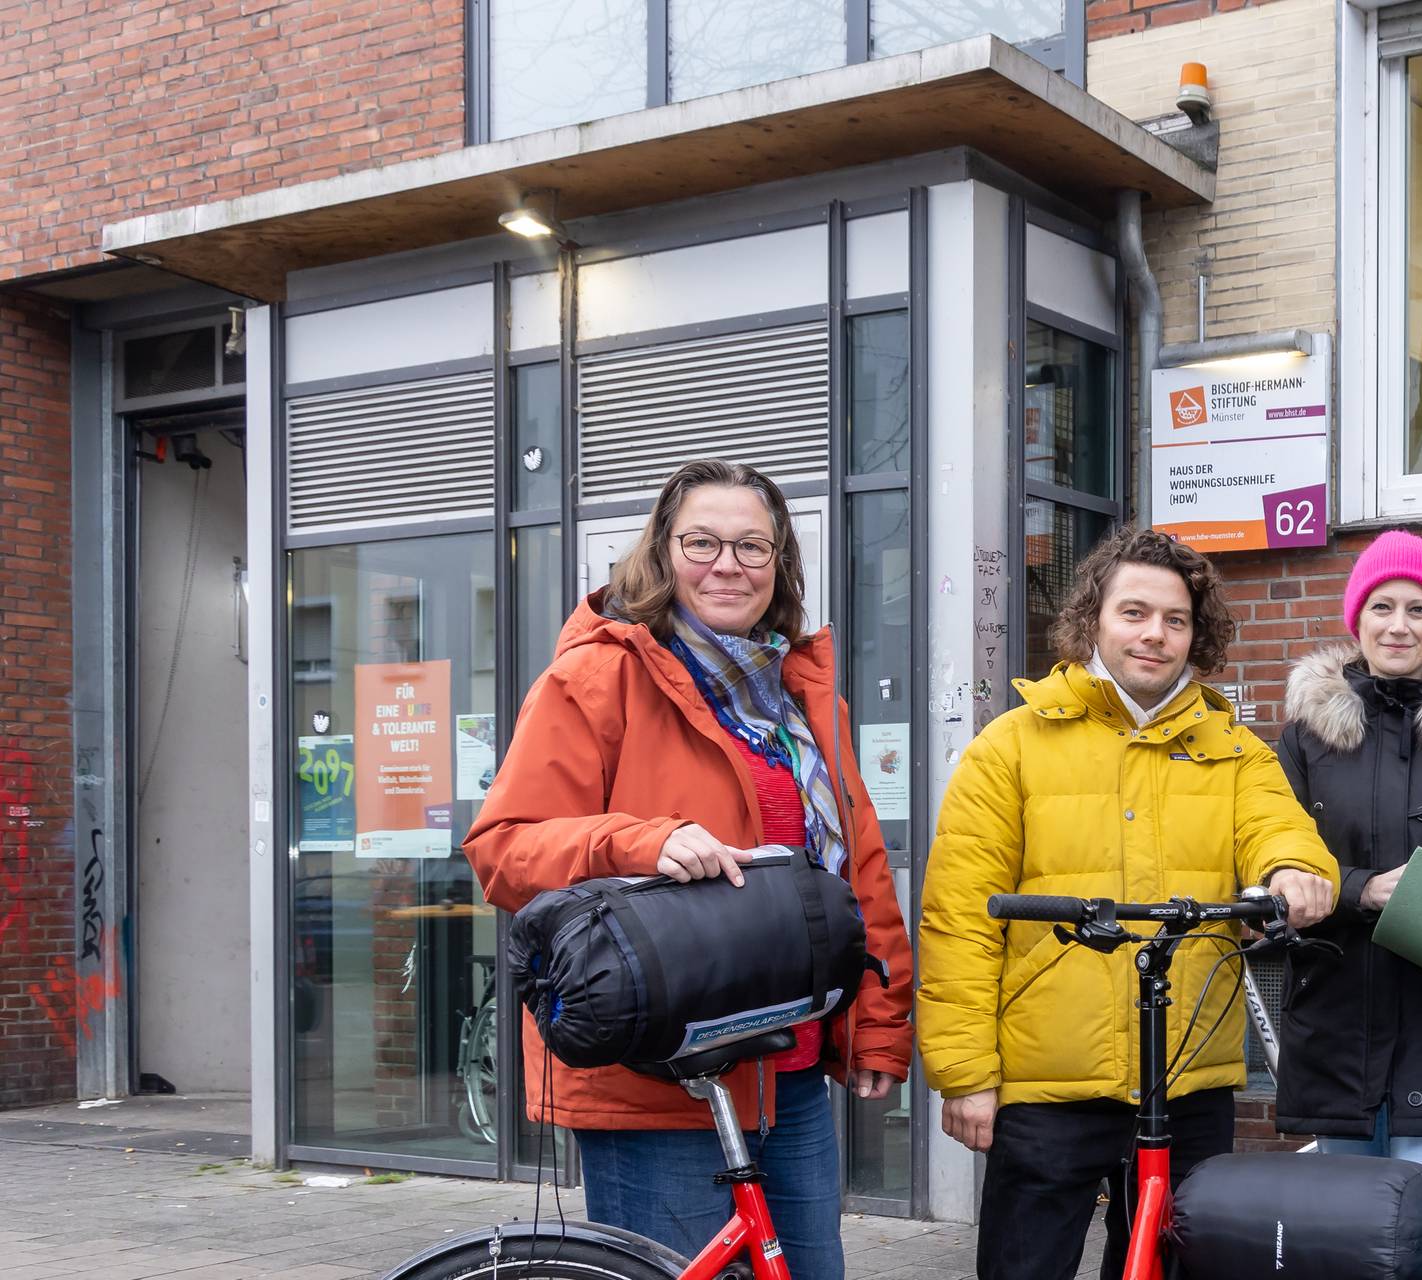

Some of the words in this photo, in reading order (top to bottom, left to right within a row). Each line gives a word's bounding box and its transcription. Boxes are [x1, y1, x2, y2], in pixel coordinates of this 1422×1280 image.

[1211, 377, 1306, 395] BISCHOF-HERMANN-
[1211, 395, 1257, 410] STIFTUNG
[1211, 412, 1245, 423] Münster
[1268, 408, 1307, 418] www.bhst.de
[1169, 465, 1194, 476] HAUS
[1195, 464, 1214, 475] DER
[1169, 473, 1276, 490] WOHNUNGSLOSENHILFE
[1169, 492, 1198, 506] (HDW)
[1275, 500, 1315, 536] 62
[395, 682, 415, 700] FÜR
[376, 704, 400, 718] EINE
[371, 723, 380, 736] &
[382, 720, 437, 735] TOLERANTE
[390, 739, 419, 752] WELT!
[299, 747, 354, 797] 2097
[1245, 975, 1277, 1048] GIANT
[696, 1009, 799, 1041] DECKENSCHLAFSACK
